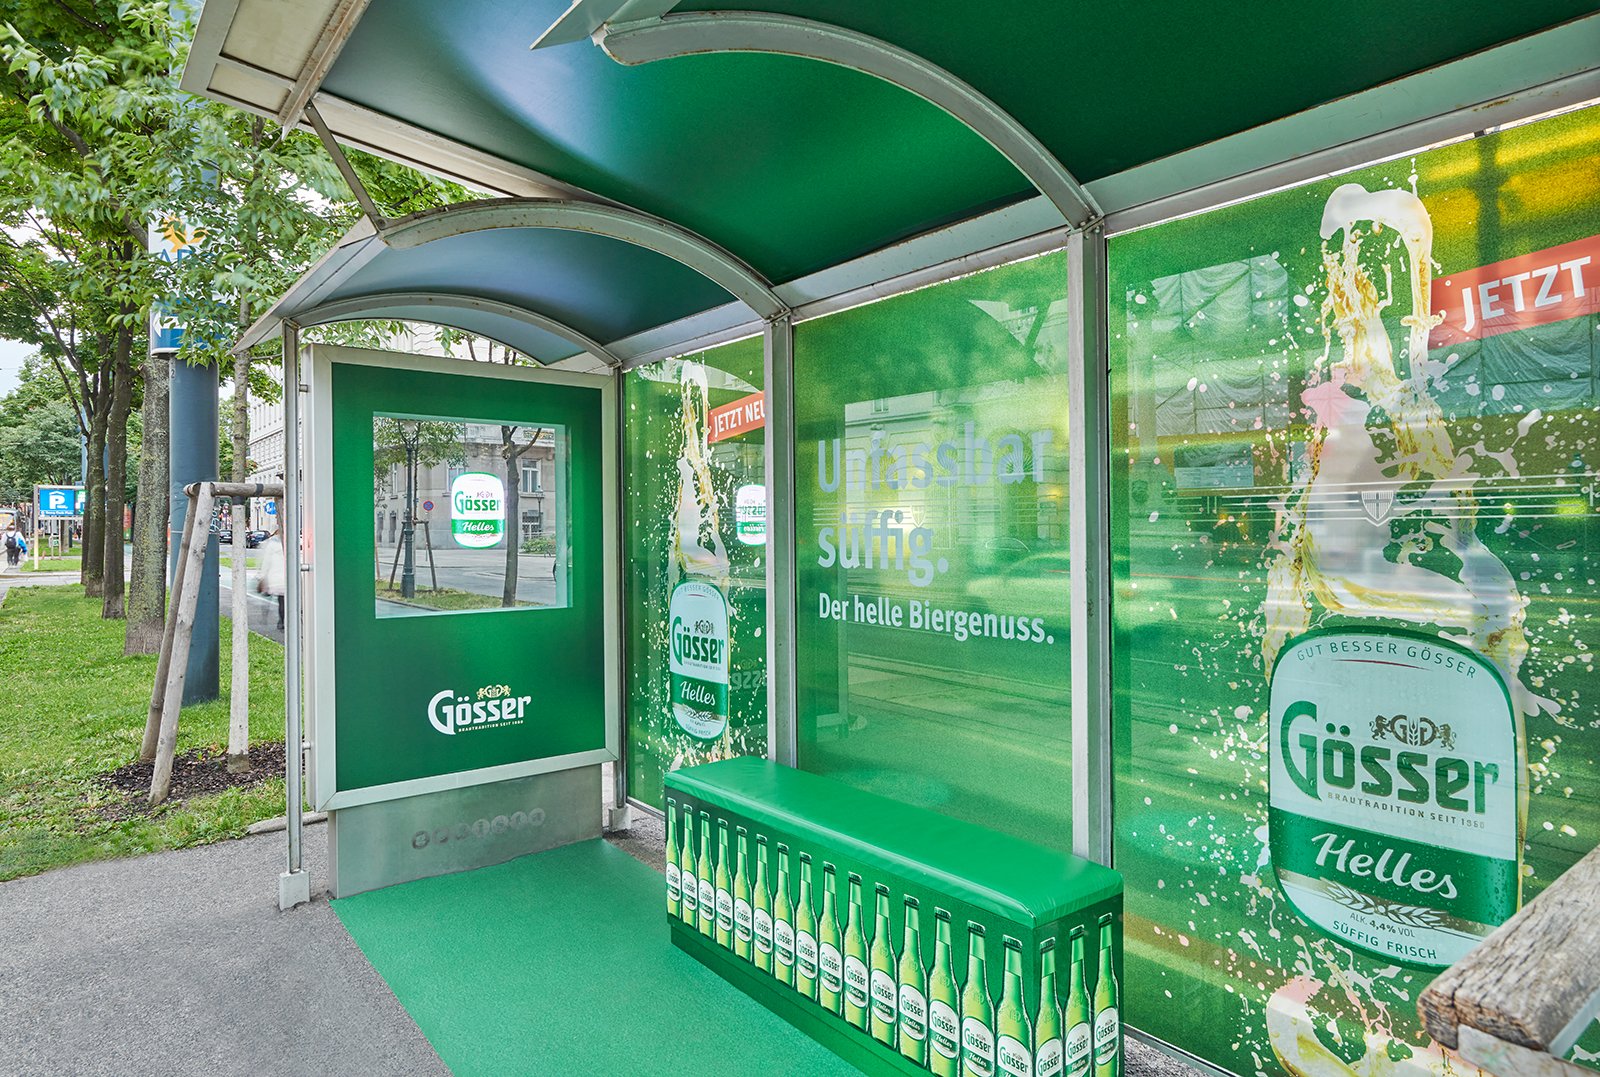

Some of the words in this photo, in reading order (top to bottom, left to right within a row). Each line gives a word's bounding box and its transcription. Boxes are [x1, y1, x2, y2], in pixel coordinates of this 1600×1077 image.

[1461, 256, 1591, 332] JETZT
[714, 406, 742, 437] JETZT
[818, 421, 1054, 493] Unfassbar
[454, 491, 501, 515] Gösser
[462, 521, 494, 531] Helles
[817, 509, 949, 587] süffig.
[819, 592, 849, 621] Der
[854, 594, 903, 627] helle
[909, 600, 1055, 645] Biergenuss.
[672, 616, 724, 666] Gösser
[1297, 644, 1322, 661] GUT
[1330, 640, 1397, 654] BESSER
[1407, 645, 1476, 678] GÖSSER
[427, 689, 532, 735] Gösser
[680, 681, 716, 706] Helles
[1280, 700, 1500, 815] Gösser
[1327, 792, 1425, 818] BRAUTRADITION
[1430, 812, 1457, 824] SEIT
[1311, 832, 1458, 899] Helles
[1333, 920, 1379, 947] SÜFFIG
[1387, 942, 1437, 960] FRISCH
[1350, 912, 1368, 926] ALK.
[1369, 920, 1396, 934] 4,4%
[1397, 924, 1415, 938] VOL
[964, 1028, 991, 1053] Gösser
[1000, 1046, 1028, 1073] Gösser
